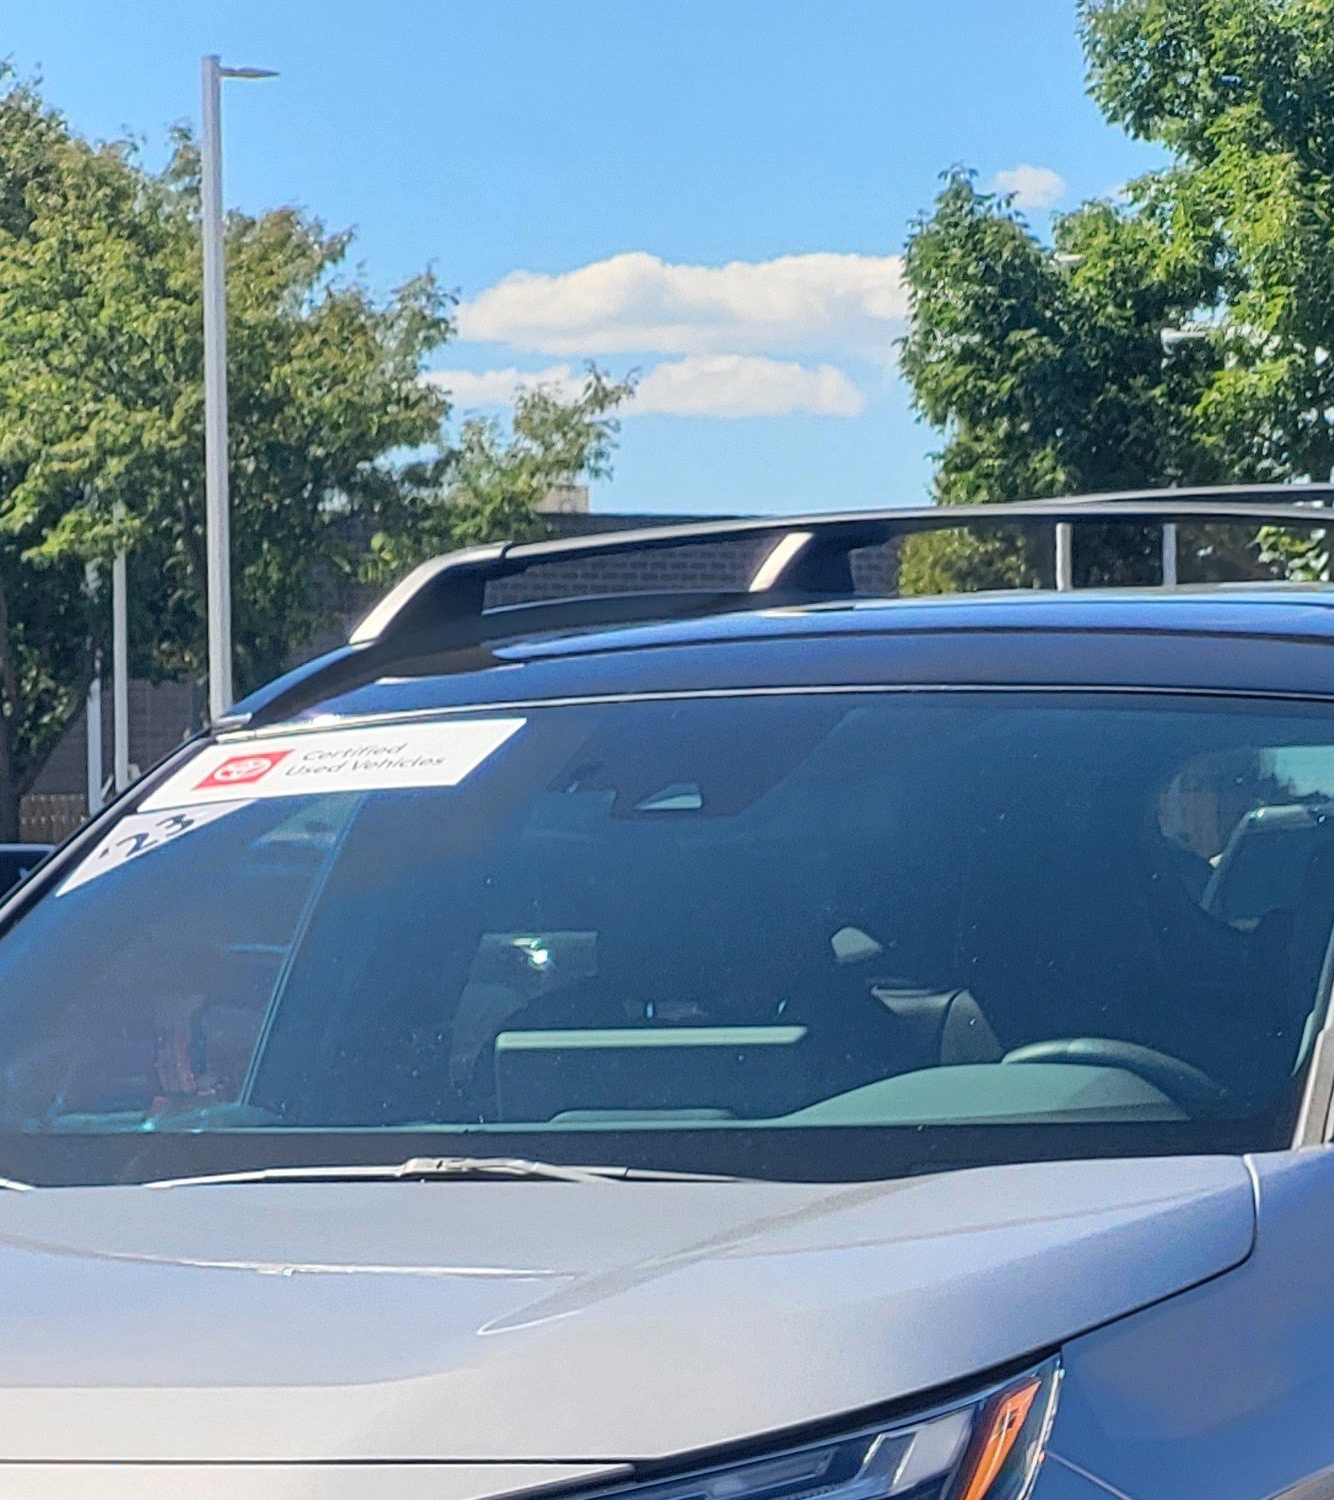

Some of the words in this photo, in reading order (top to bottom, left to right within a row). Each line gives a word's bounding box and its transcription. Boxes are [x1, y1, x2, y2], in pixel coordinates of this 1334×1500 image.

[303, 742, 408, 763] Certified
[284, 760, 348, 778] Used
[350, 753, 446, 772] Vehicles
[98, 812, 196, 860] '23
